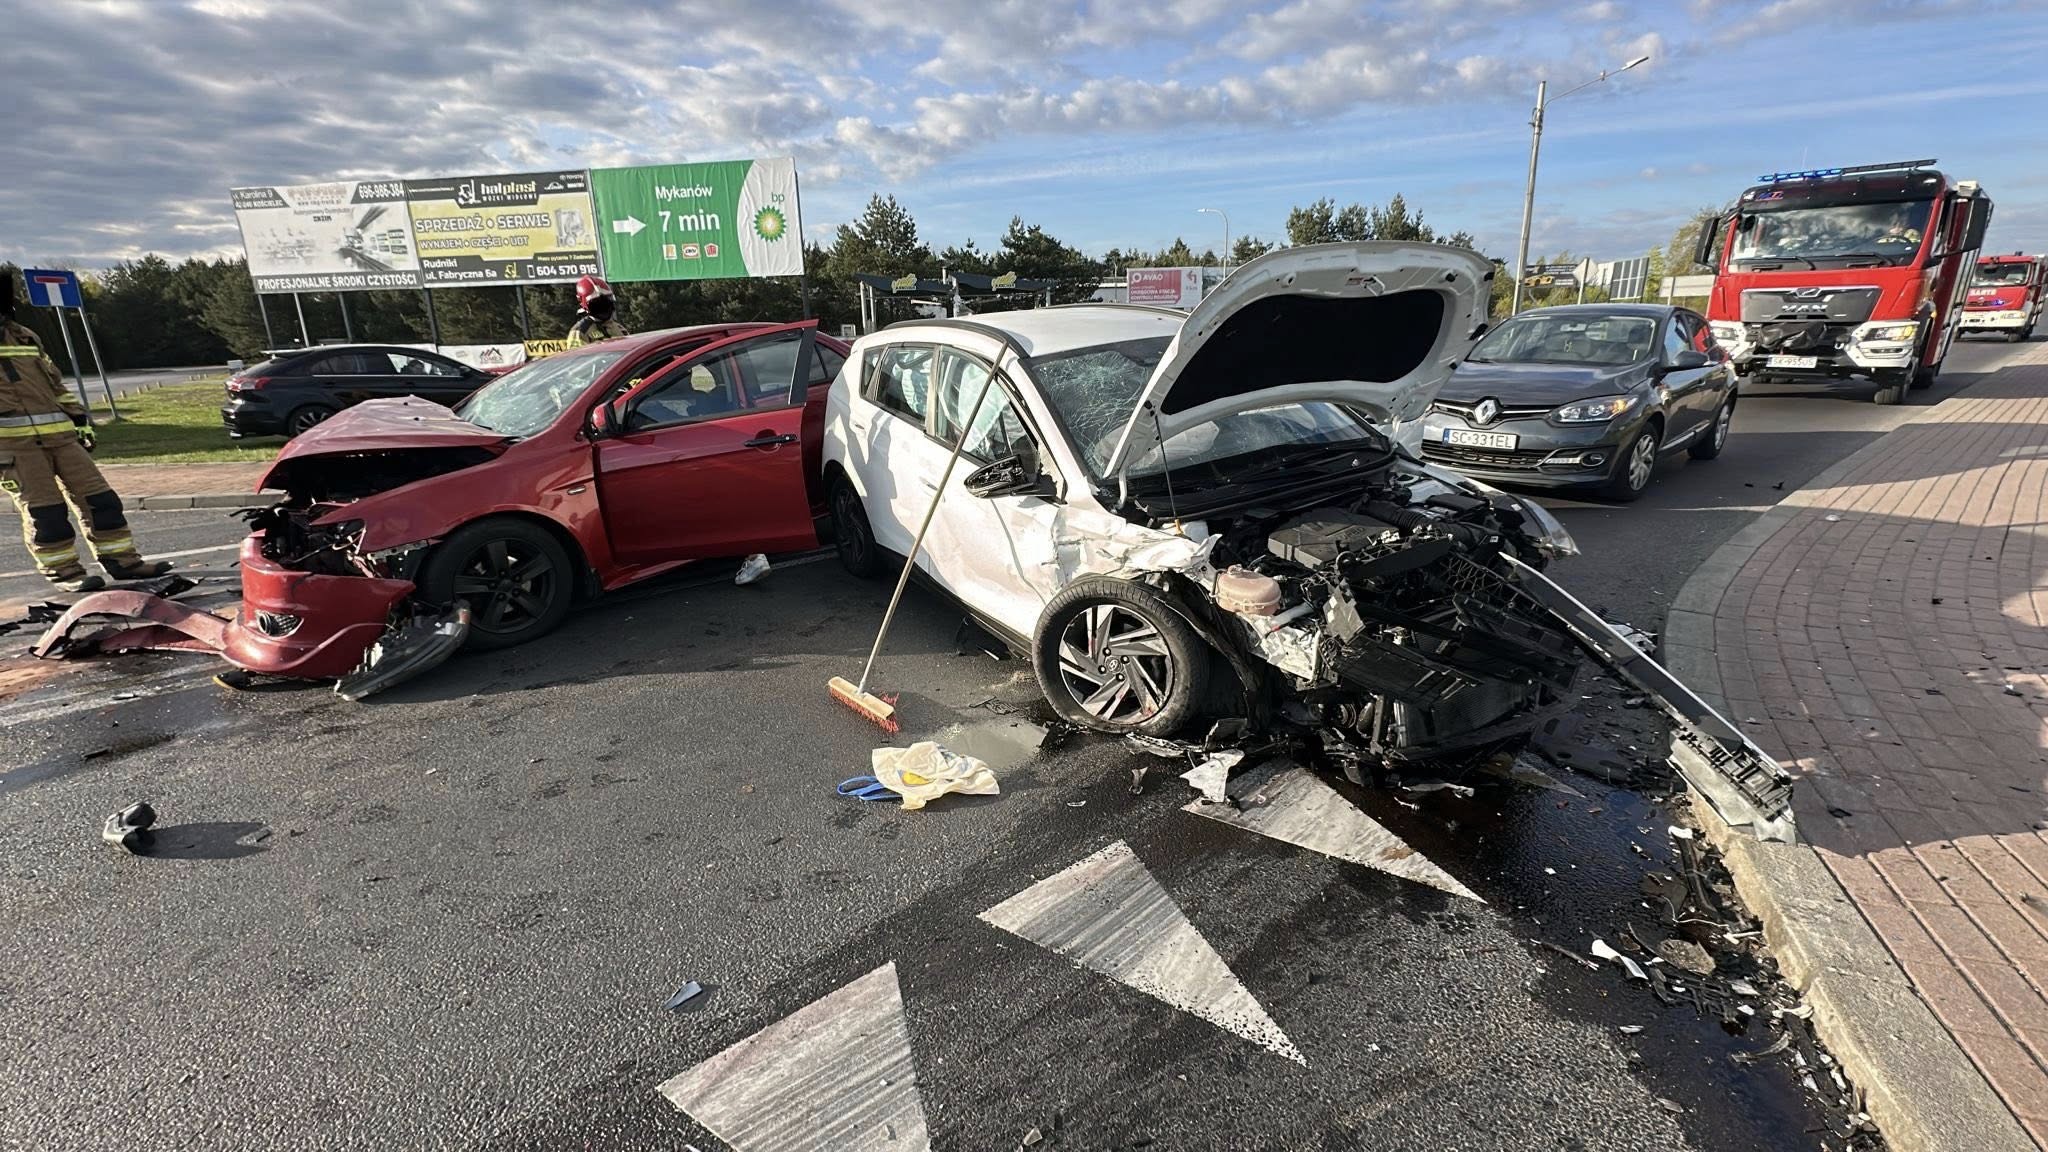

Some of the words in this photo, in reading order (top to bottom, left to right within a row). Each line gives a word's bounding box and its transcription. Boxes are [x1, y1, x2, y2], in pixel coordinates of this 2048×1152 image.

[358, 182, 405, 199] 696-986-384
[481, 180, 537, 195] halplast
[655, 184, 713, 202] Mykanów
[771, 192, 785, 205] bp
[415, 213, 484, 233] SPRZEDAŻ
[497, 213, 551, 229] SERWIS
[658, 211, 671, 233] 7
[678, 208, 721, 231] min
[420, 238, 462, 250] WYNAJEM
[471, 235, 502, 250] CZĘŚCI
[510, 235, 529, 246] UDT
[423, 258, 458, 268] Rudniki
[536, 265, 558, 276] 604
[558, 264, 578, 275] 570
[578, 263, 598, 274] 916
[257, 276, 332, 290] PROFESJONALNE
[333, 273, 366, 287] ŚRODKI
[367, 271, 418, 286] CZYSTOŚCI
[438, 270, 484, 281] Fabryczna
[484, 268, 498, 278] 6a
[1451, 431, 1468, 444] SC
[1472, 433, 1513, 449] 331EL
